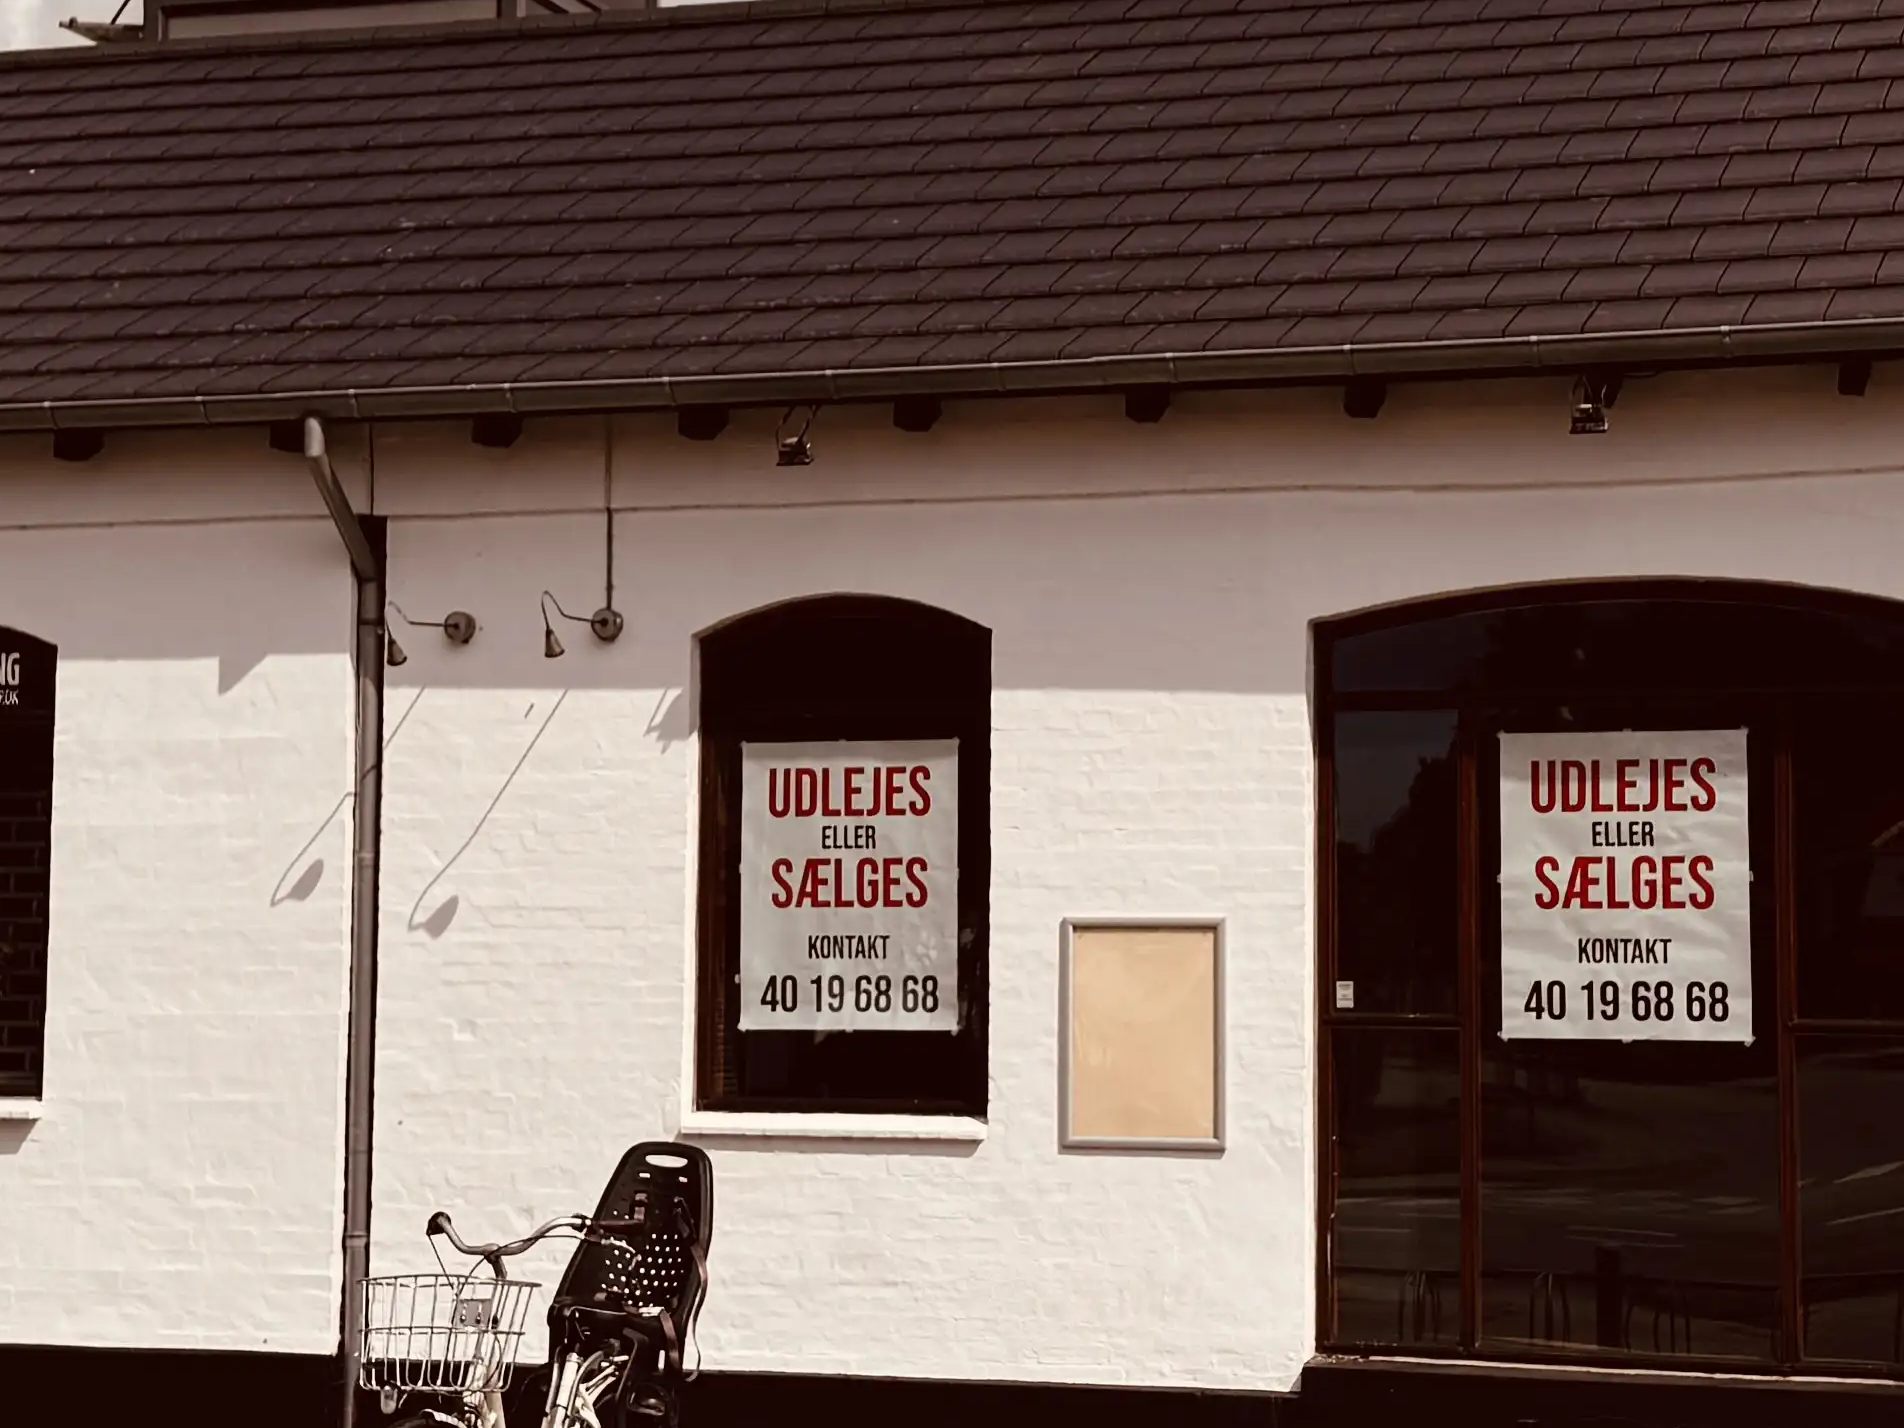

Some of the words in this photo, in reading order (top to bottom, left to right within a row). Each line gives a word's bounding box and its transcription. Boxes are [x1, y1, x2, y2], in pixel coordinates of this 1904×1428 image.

[769, 766, 930, 818] UDLEJES
[1531, 757, 1716, 813] UDLEJES
[822, 825, 876, 849] ELLER
[1592, 821, 1654, 846] ELLER
[772, 857, 927, 908] SÆLGES
[1535, 855, 1714, 909] SÆLGES
[809, 935, 890, 959] KONTAKT
[1579, 938, 1671, 963] KONTAKT
[761, 975, 797, 1012] 40
[811, 975, 844, 1012] 19
[855, 975, 891, 1012] 68
[903, 975, 938, 1013] 68
[1524, 981, 1566, 1020] 40
[1581, 981, 1619, 1020] 19
[1632, 981, 1674, 1021] 68
[1687, 981, 1728, 1022] 68
